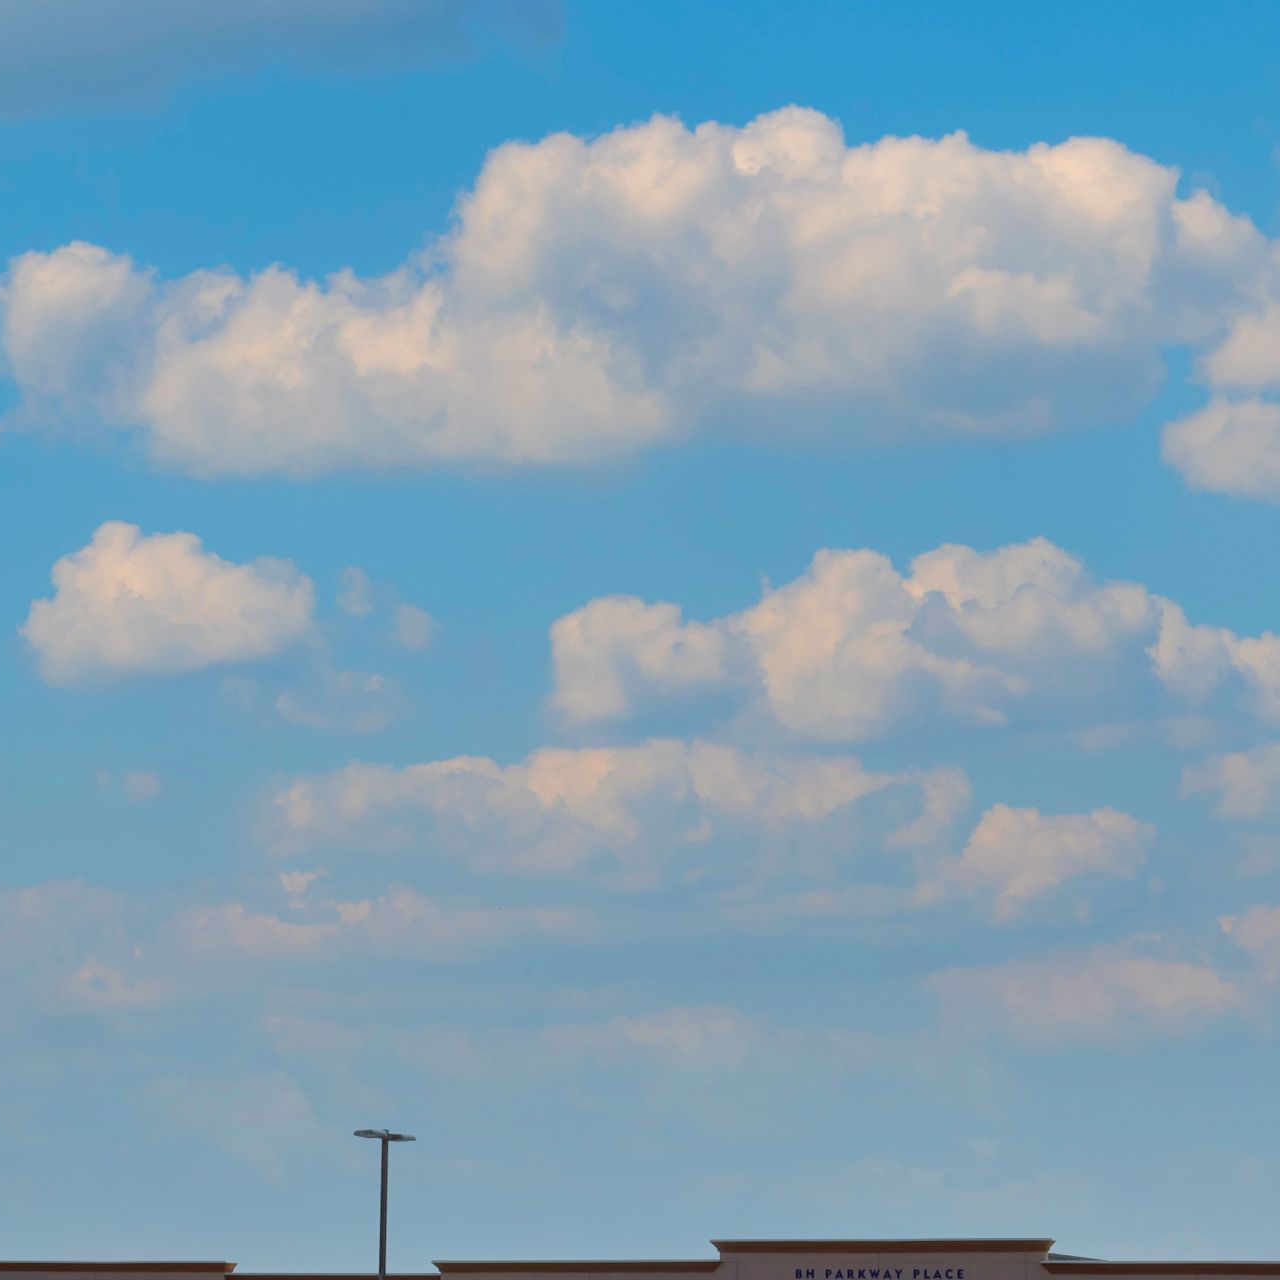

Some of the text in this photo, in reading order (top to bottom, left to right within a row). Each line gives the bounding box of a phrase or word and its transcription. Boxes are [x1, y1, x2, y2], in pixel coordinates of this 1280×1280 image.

[795, 1269, 964, 1279] BH PARKWAY PLACE
